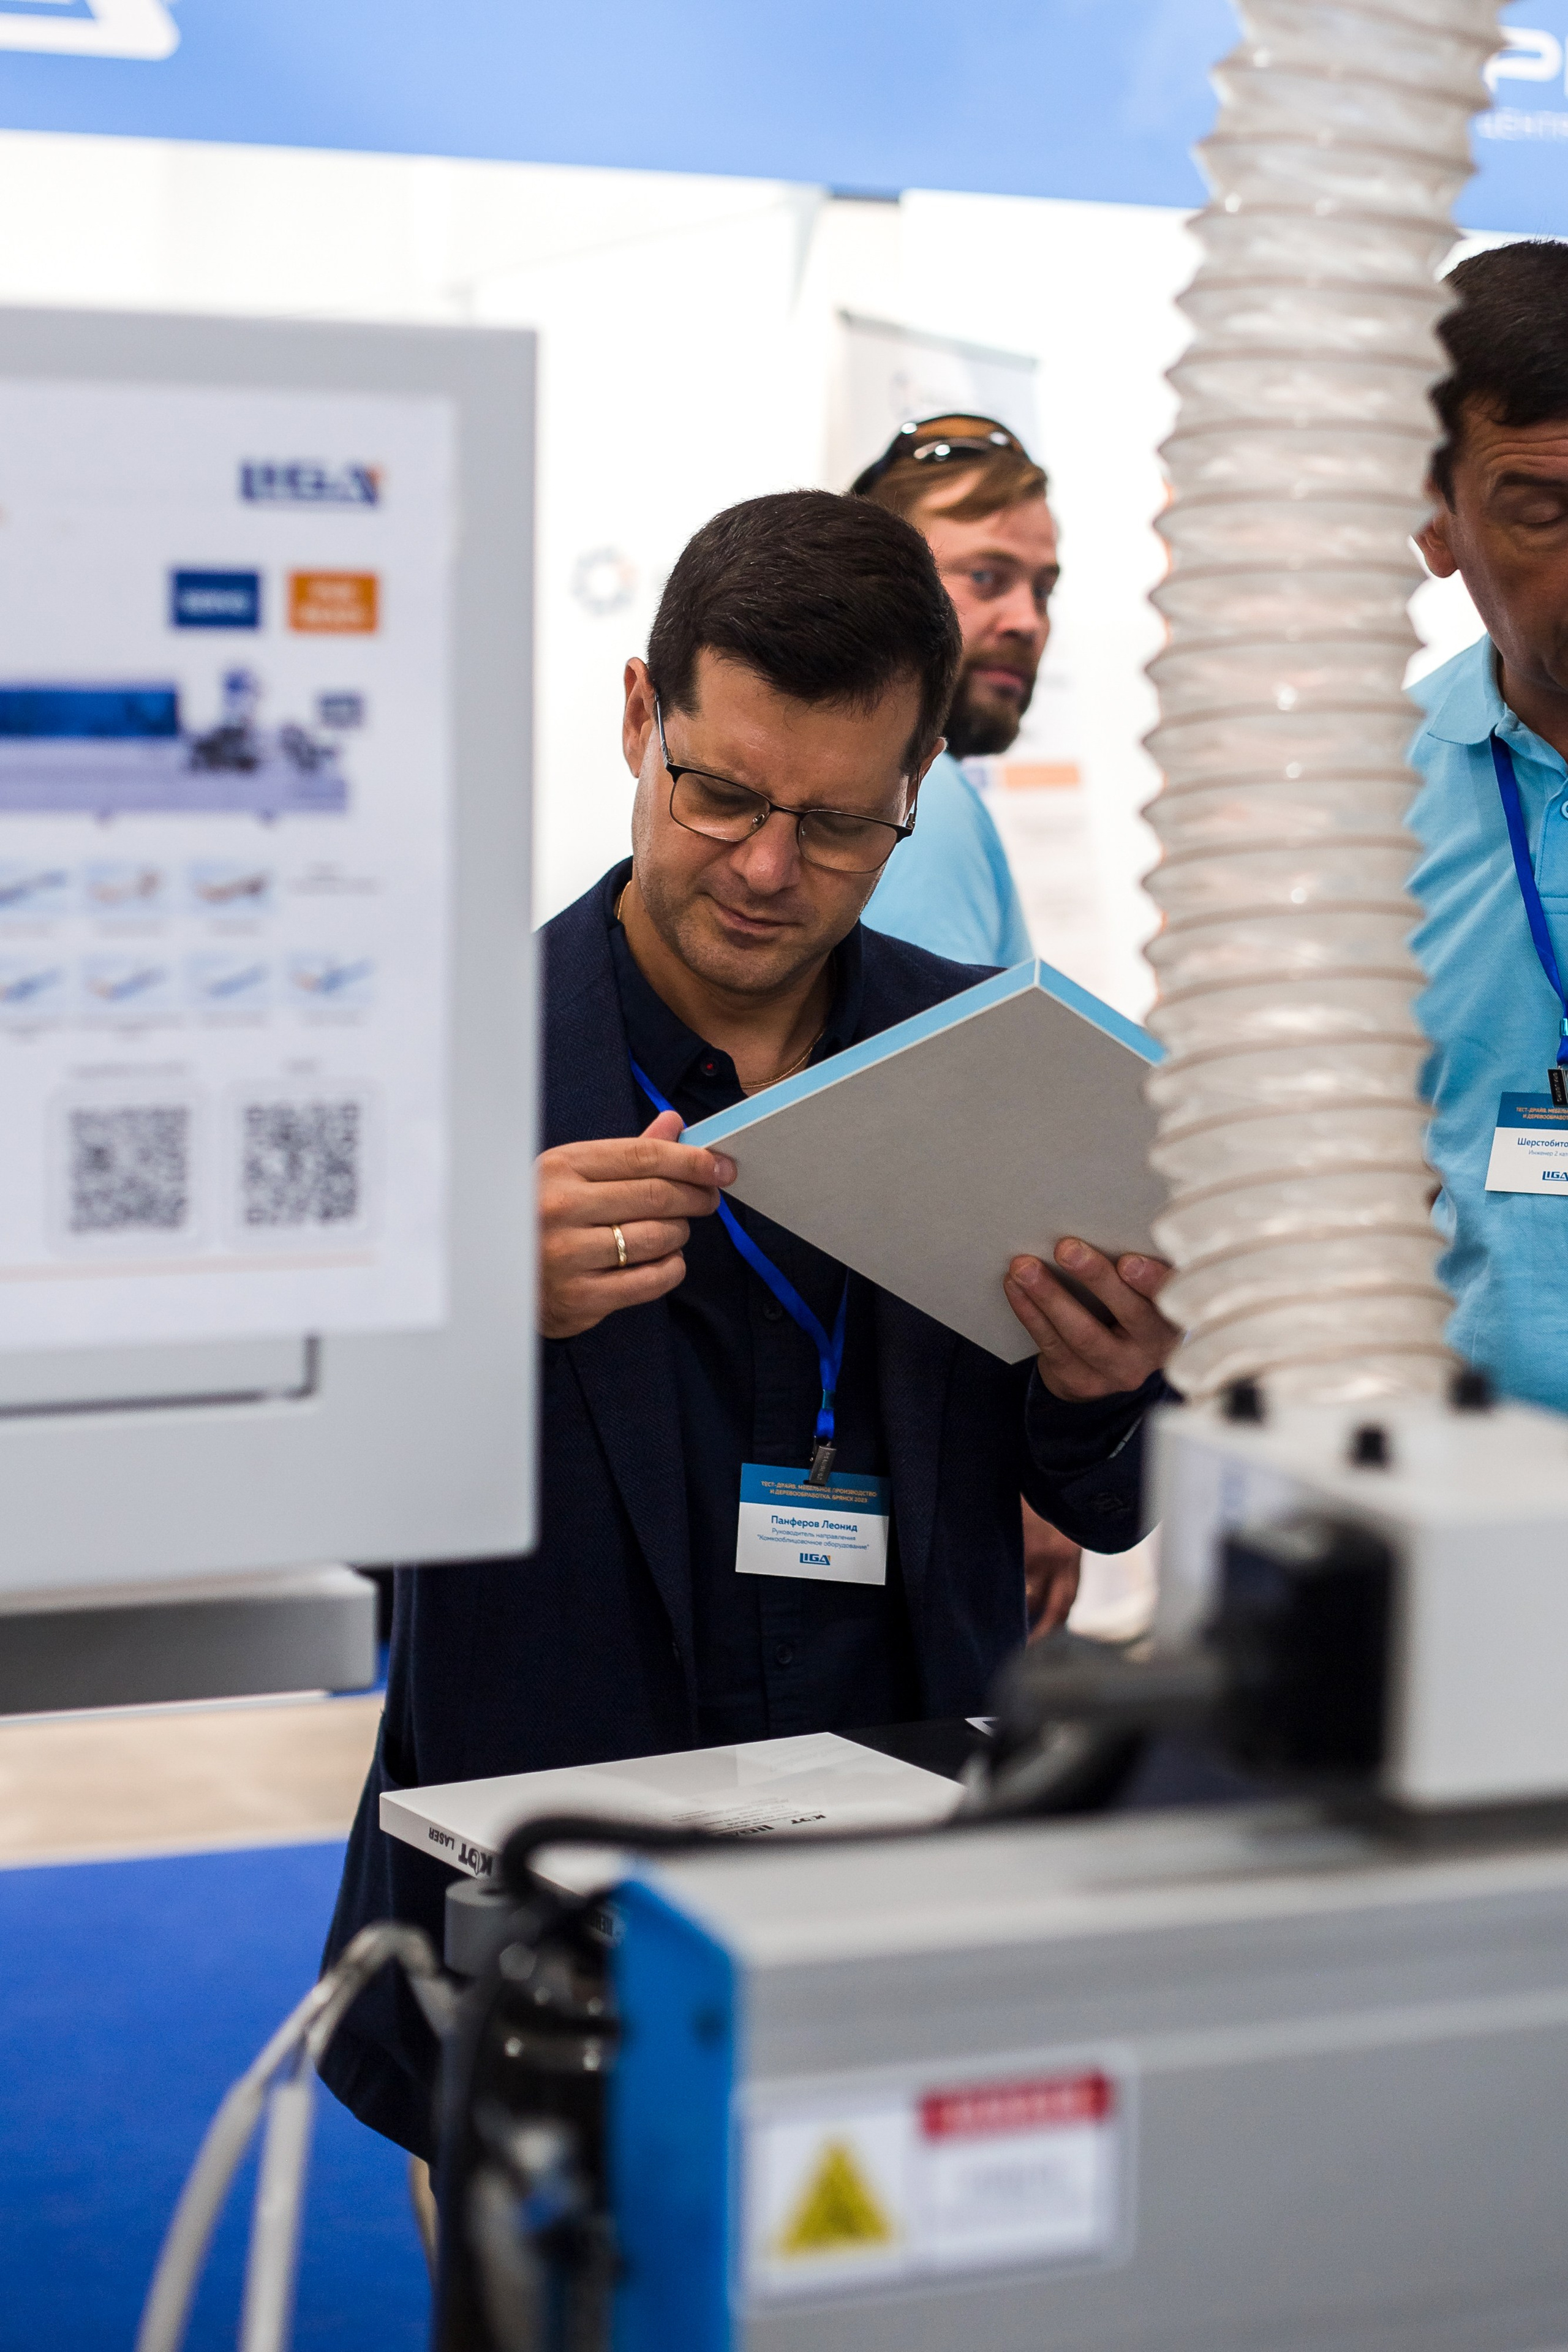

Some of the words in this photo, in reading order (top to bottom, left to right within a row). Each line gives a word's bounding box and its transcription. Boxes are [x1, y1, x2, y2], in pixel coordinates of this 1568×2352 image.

[771, 1515, 820, 1529] Панферов
[821, 1520, 858, 1532] Леонид
[772, 1528, 815, 1537] Руководитель
[799, 1553, 831, 1566] LIGA
[429, 1827, 454, 1850] LASER
